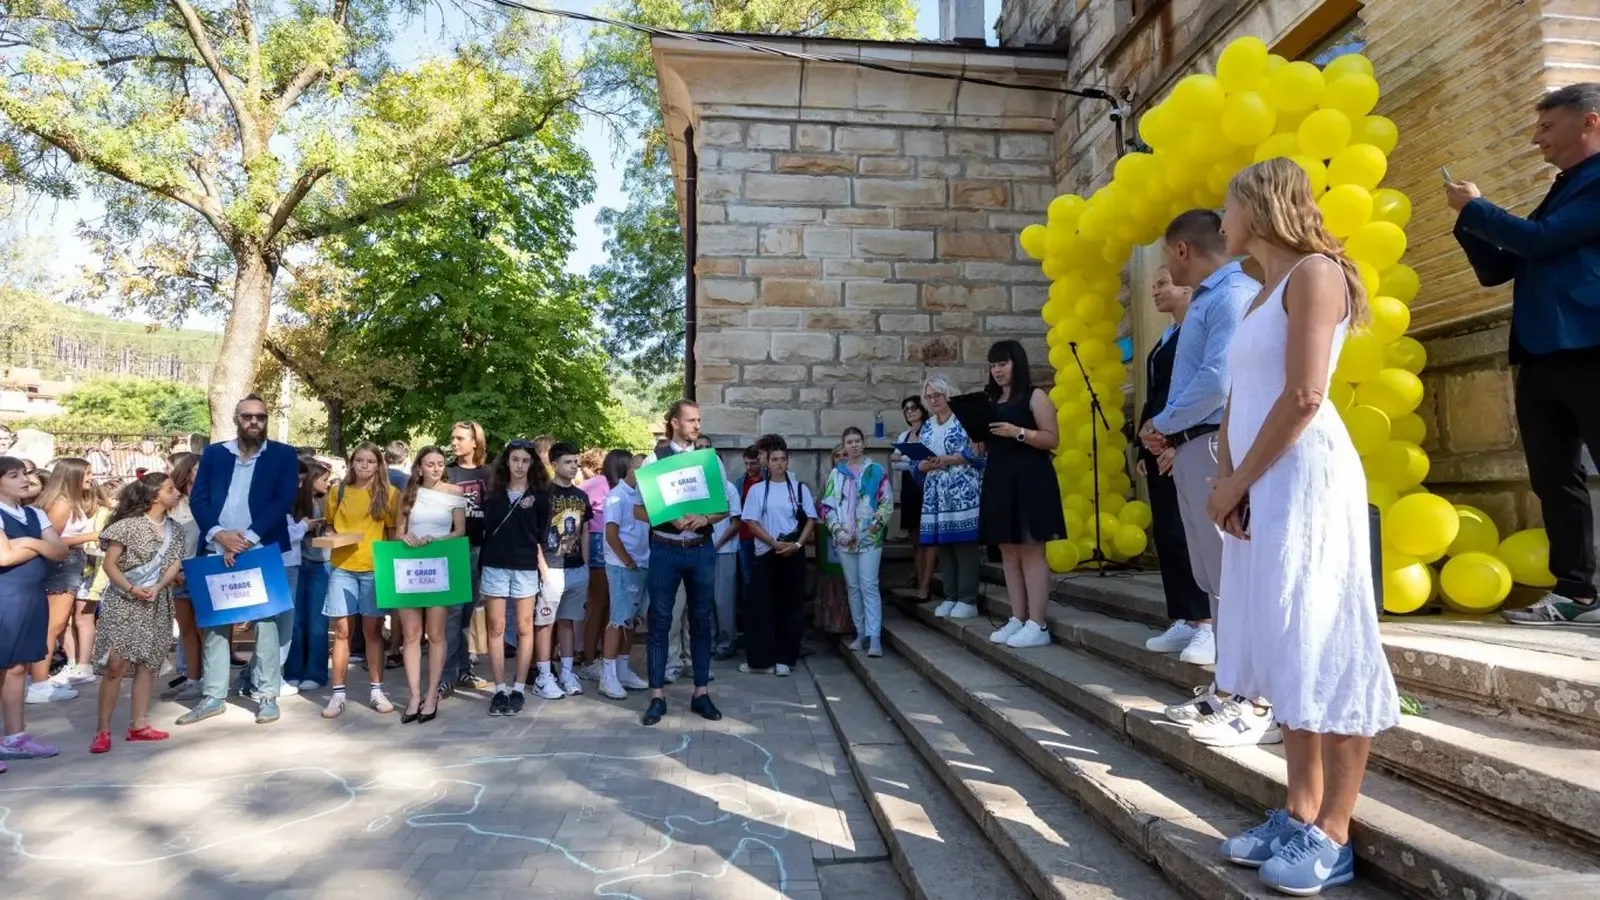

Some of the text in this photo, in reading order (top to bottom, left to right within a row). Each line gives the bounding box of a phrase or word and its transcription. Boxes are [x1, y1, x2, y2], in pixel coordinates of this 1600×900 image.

[677, 476, 697, 485] GRADE
[471, 510, 485, 518] PAR
[228, 581, 252, 590] GRADE
